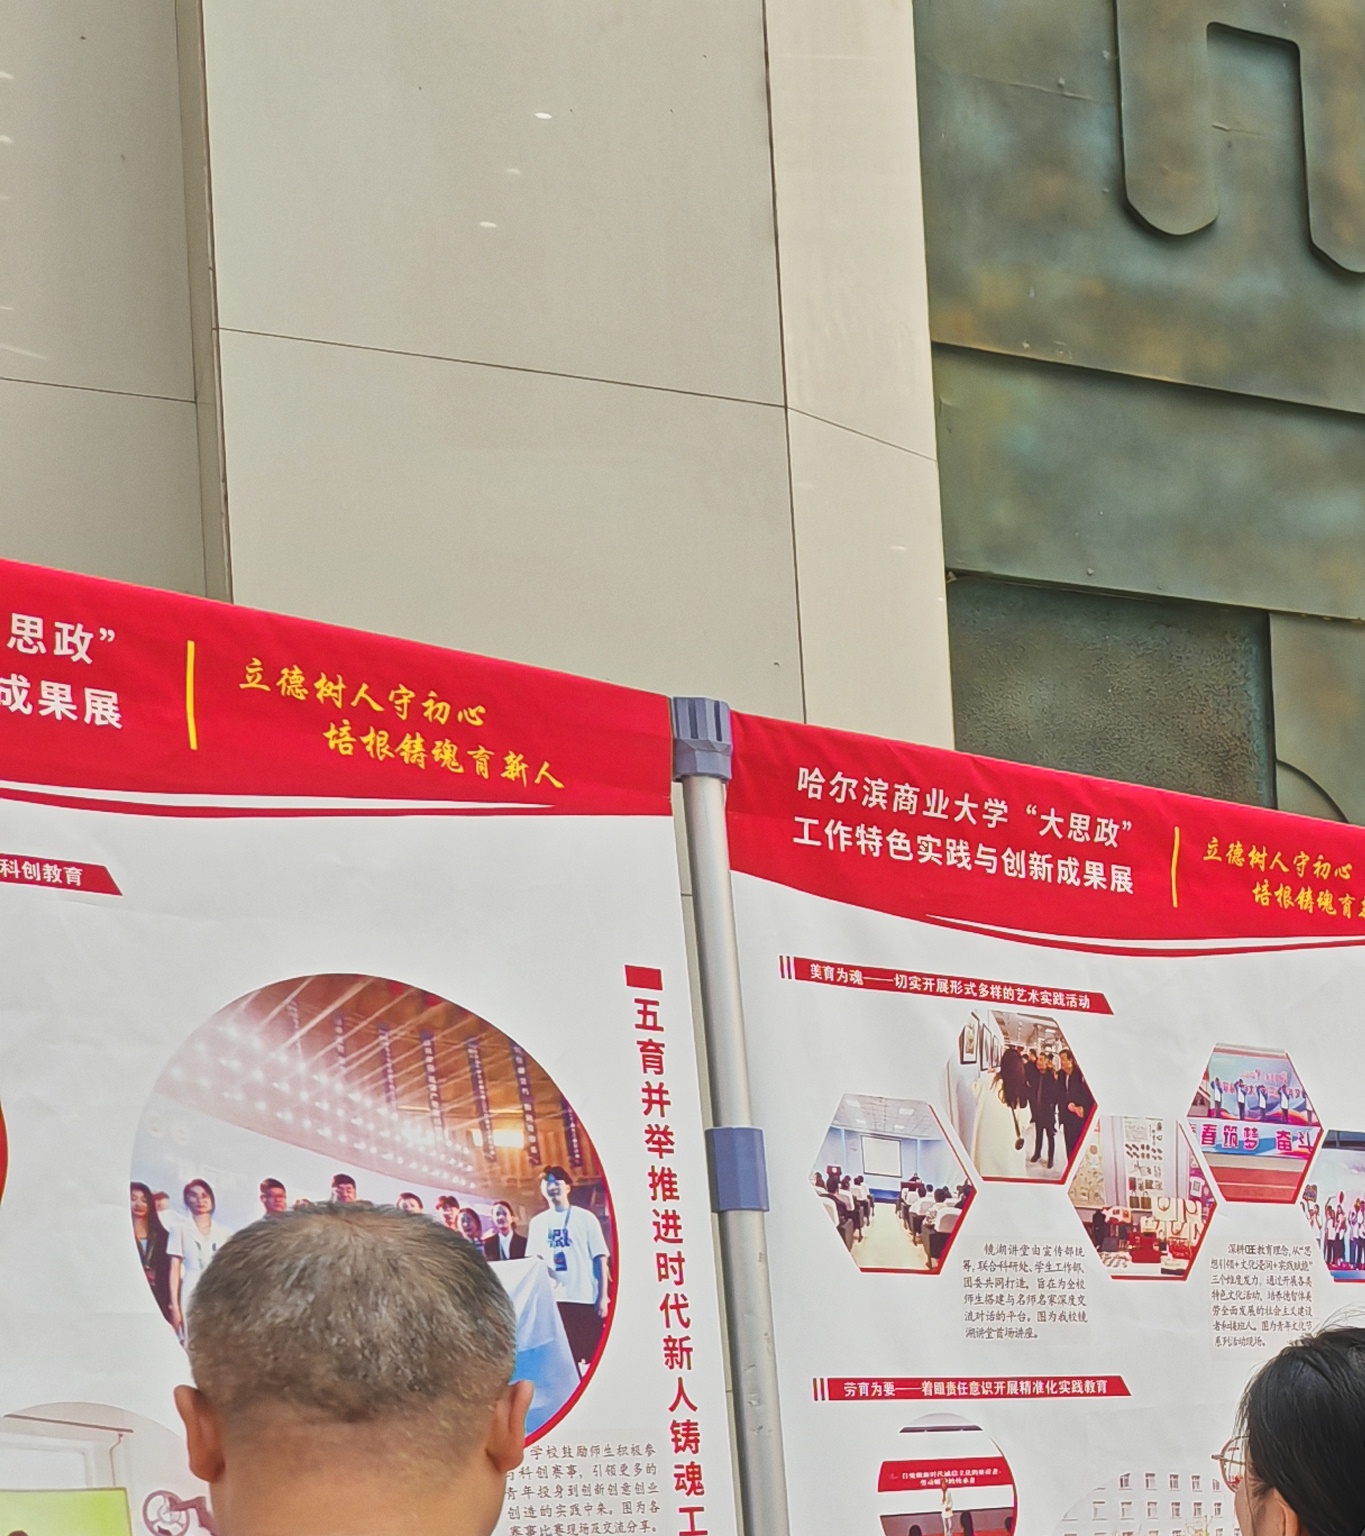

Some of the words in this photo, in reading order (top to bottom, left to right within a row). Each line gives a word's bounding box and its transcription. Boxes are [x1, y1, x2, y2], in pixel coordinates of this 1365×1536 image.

[6, 612, 116, 664] 思政”
[0, 673, 123, 729] 成果展
[239, 657, 487, 728] 立德树人守初心
[323, 719, 565, 790] 培根铸魂育新人
[797, 767, 1133, 848] 哈尔滨商业大学“大思政”
[792, 817, 1133, 894] 工作特色实践与创新成果展
[1203, 836, 1353, 880] 立德树人守初心
[1189, 1122, 1260, 1150] 春筑梦
[530, 1443, 657, 1460] 学校鼓励师生积极参
[507, 1500, 661, 1520] 创造的实践中来。图为各
